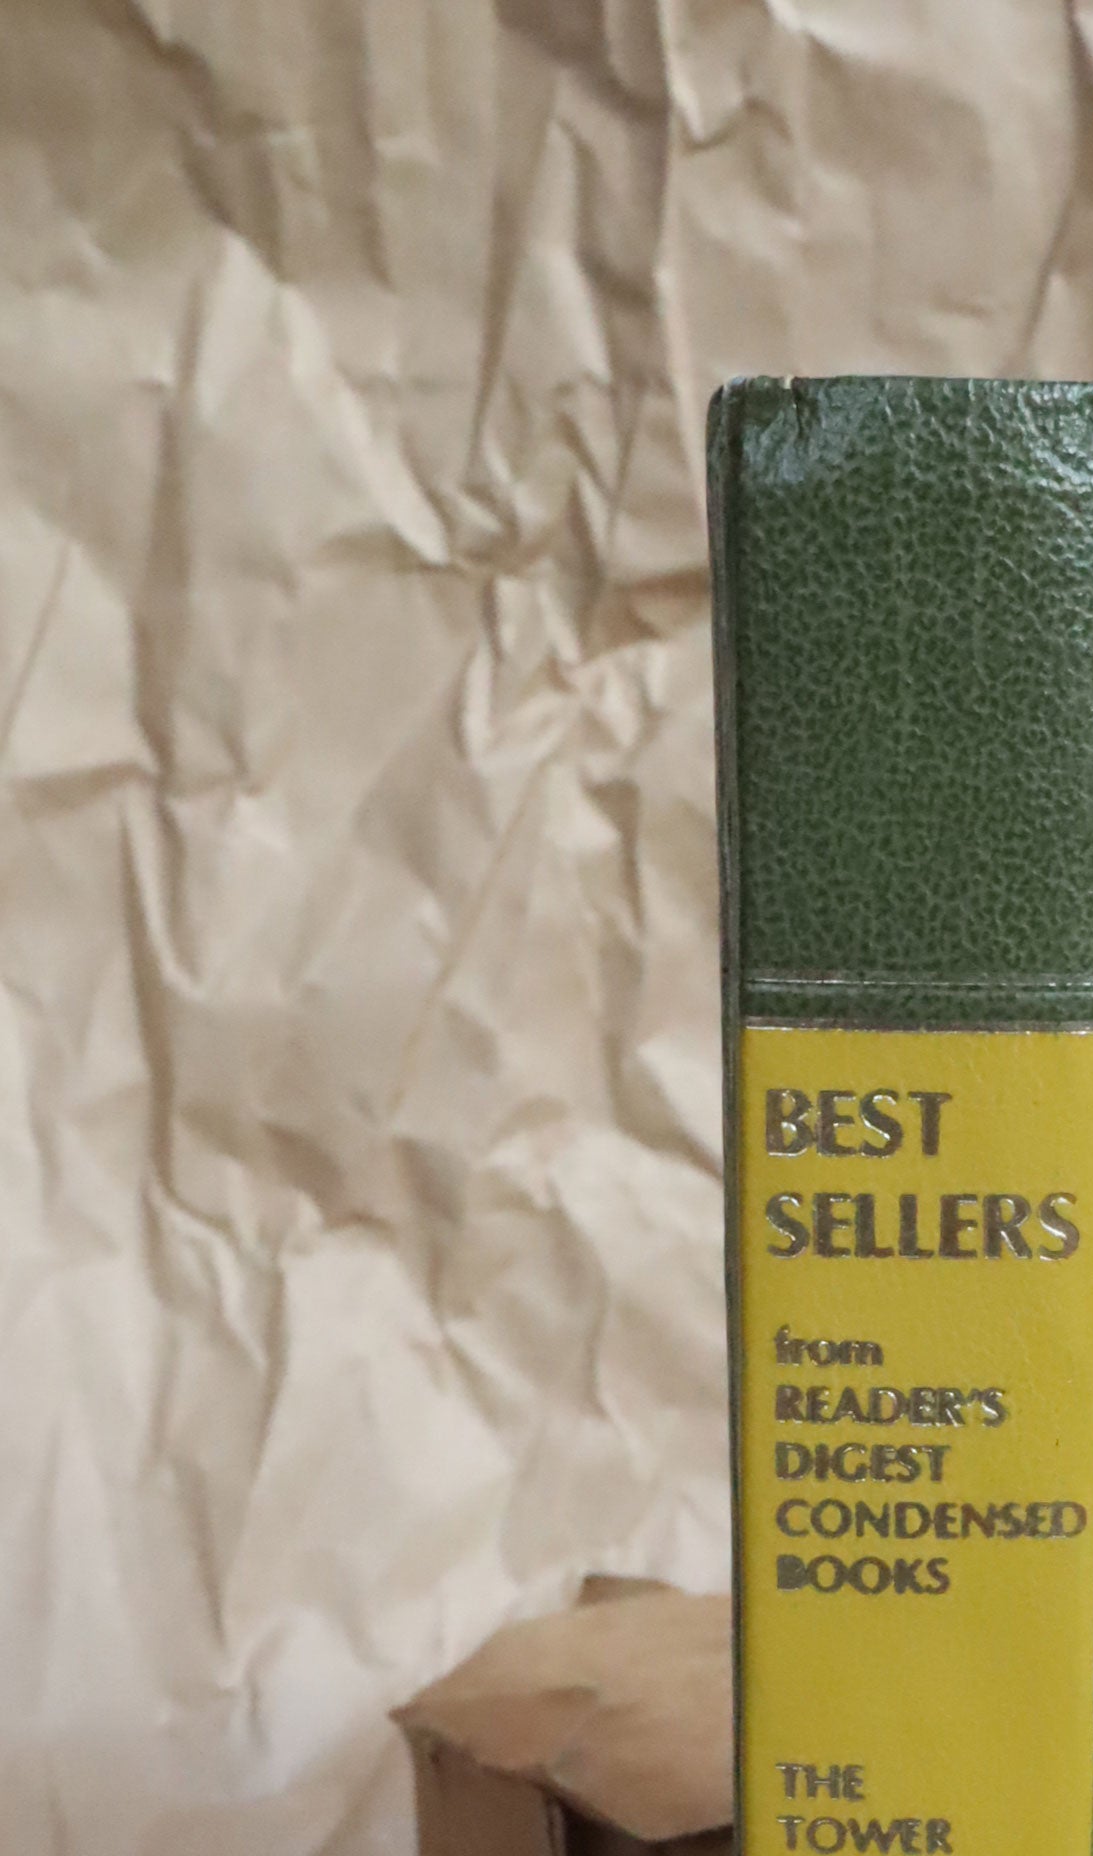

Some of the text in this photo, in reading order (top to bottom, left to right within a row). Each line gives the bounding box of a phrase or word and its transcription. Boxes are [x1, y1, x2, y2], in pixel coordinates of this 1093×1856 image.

[765, 1089, 951, 1157] BEST
[765, 1192, 1081, 1261] SELLERS
[774, 1325, 883, 1366] from
[774, 1385, 1009, 1427] READER'S
[774, 1443, 951, 1482] DIGEST
[775, 1500, 1088, 1539] CONDENSED
[775, 1555, 952, 1595] BOOKS
[776, 1762, 865, 1801] THE
[776, 1816, 953, 1855] TOWER
